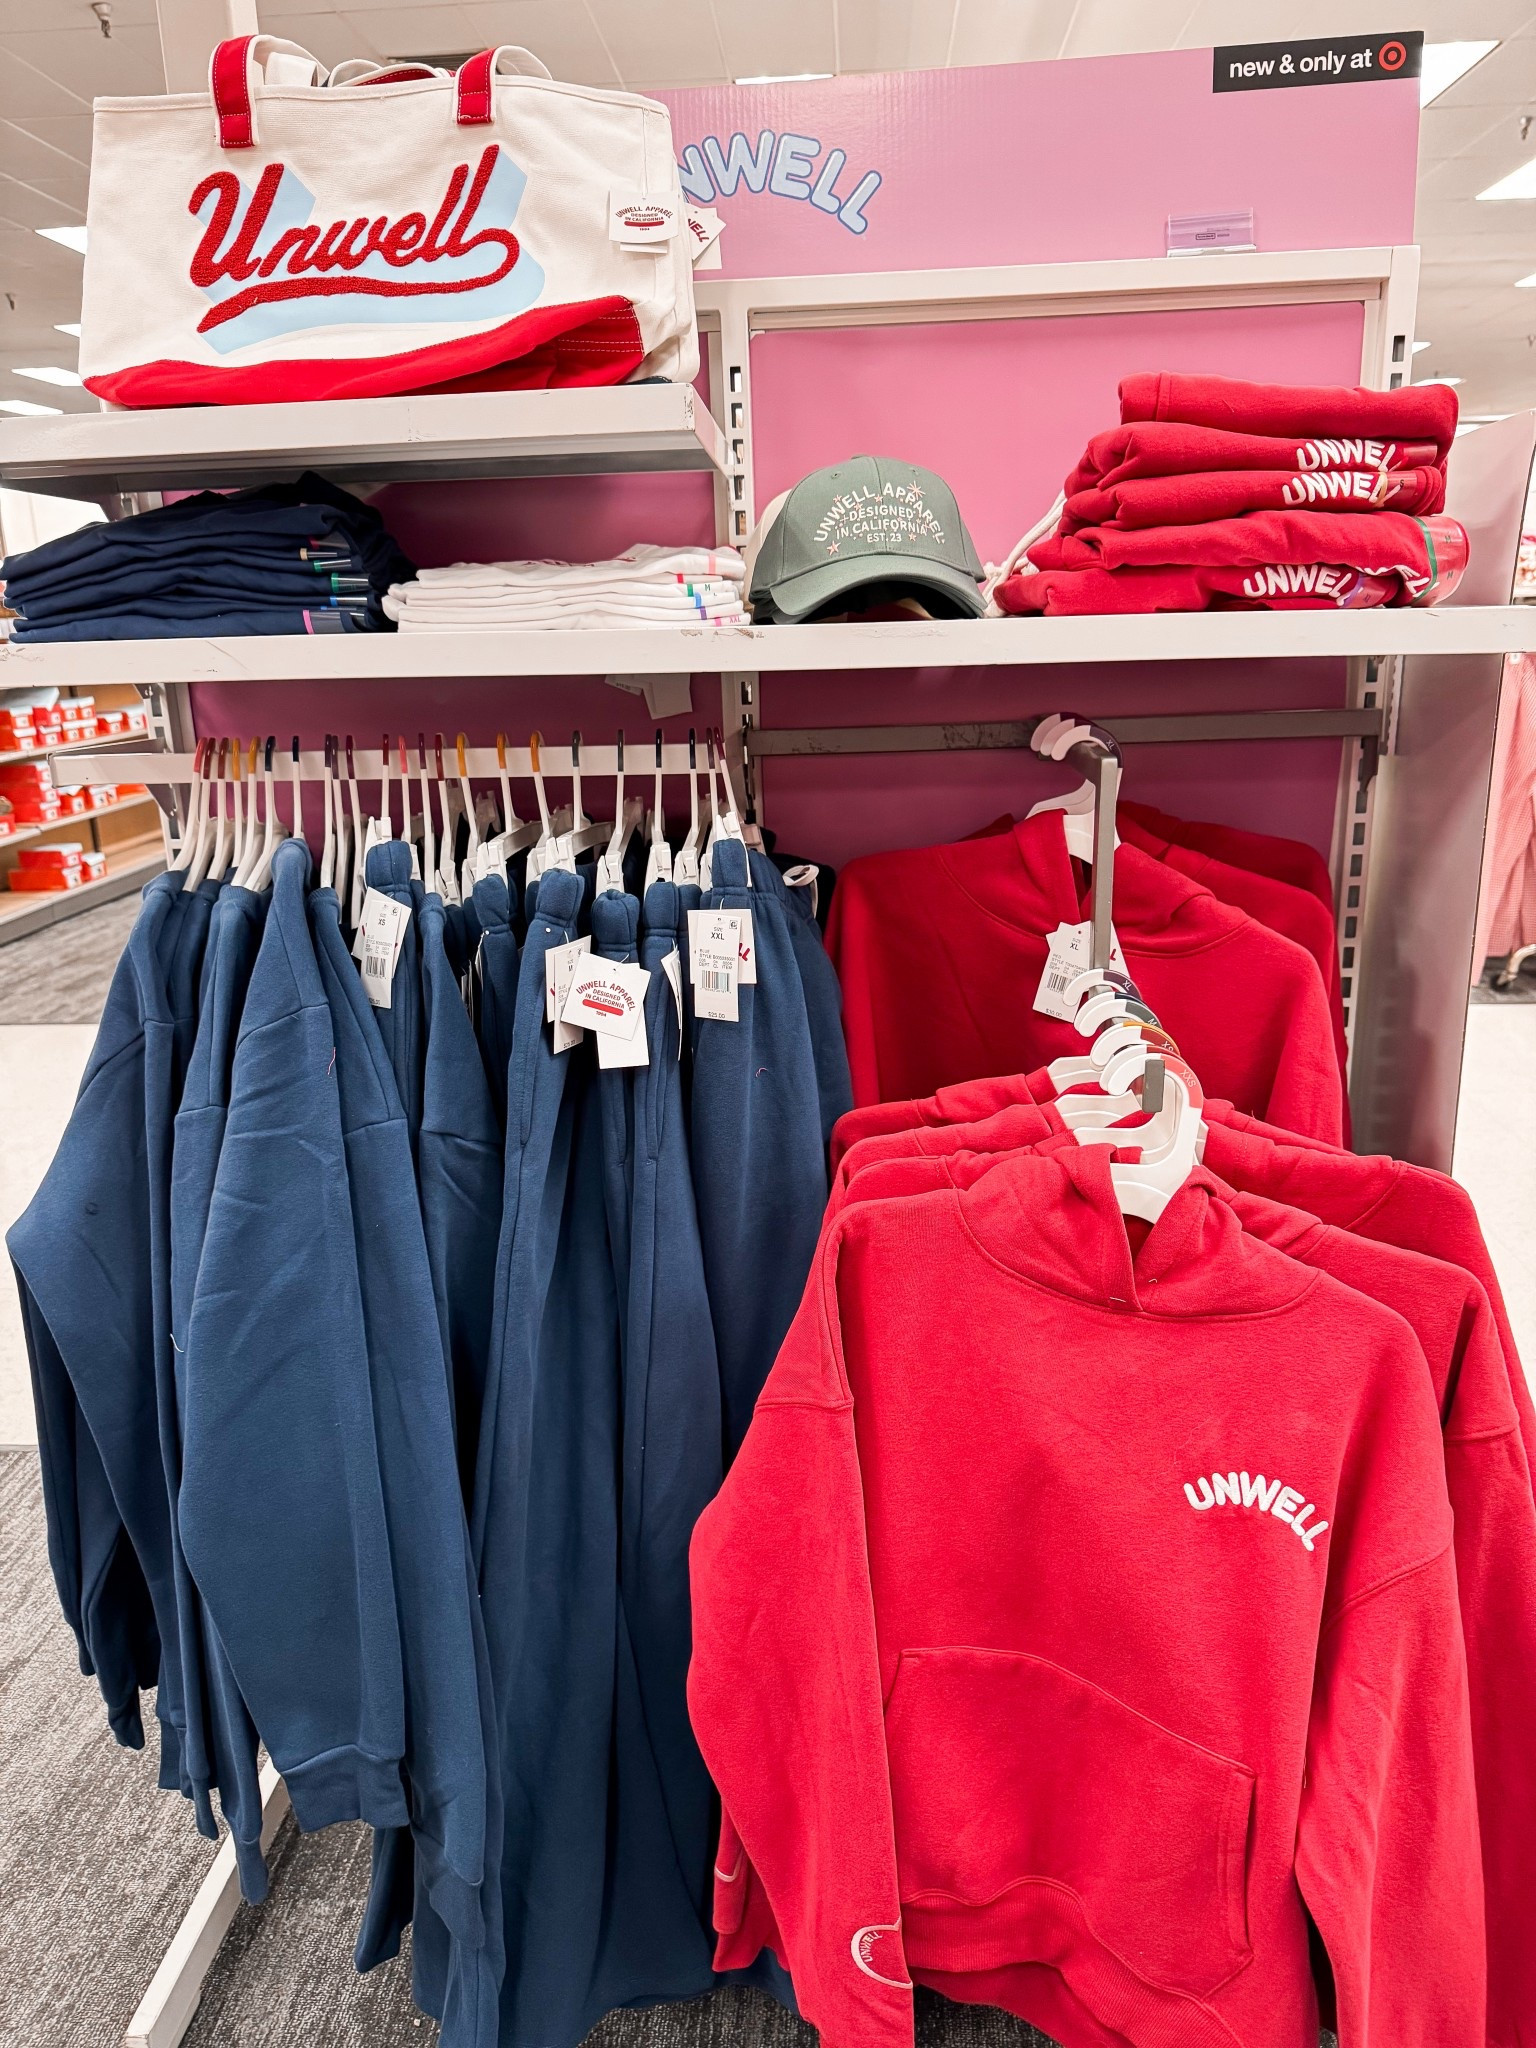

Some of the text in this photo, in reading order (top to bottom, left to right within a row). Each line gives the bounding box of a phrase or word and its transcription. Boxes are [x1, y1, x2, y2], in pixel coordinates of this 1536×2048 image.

[1229, 49, 1373, 78] new & only at
[678, 128, 883, 235] NWELL
[188, 144, 519, 288] Unwell
[615, 206, 674, 219] UNWELL APPAREL
[813, 482, 945, 544] UNWELL APPAREL
[848, 504, 914, 520] DESIGNED
[835, 519, 927, 540] IN CALIFORNIA
[704, 583, 711, 592] M
[1105, 739, 1115, 750] XL
[377, 918, 386, 927] XS
[710, 931, 725, 941] XXL
[1069, 942, 1079, 951] XL
[1122, 979, 1132, 991] XL
[576, 980, 608, 995] UNWELL
[609, 983, 636, 1012] APPAREL
[592, 988, 621, 1001] DESIGNED
[592, 996, 625, 1009] CALIFORNIA
[1180, 1069, 1196, 1088] XXS
[1183, 1470, 1329, 1552] UNWELL
[859, 1930, 883, 1963] UNWELL
